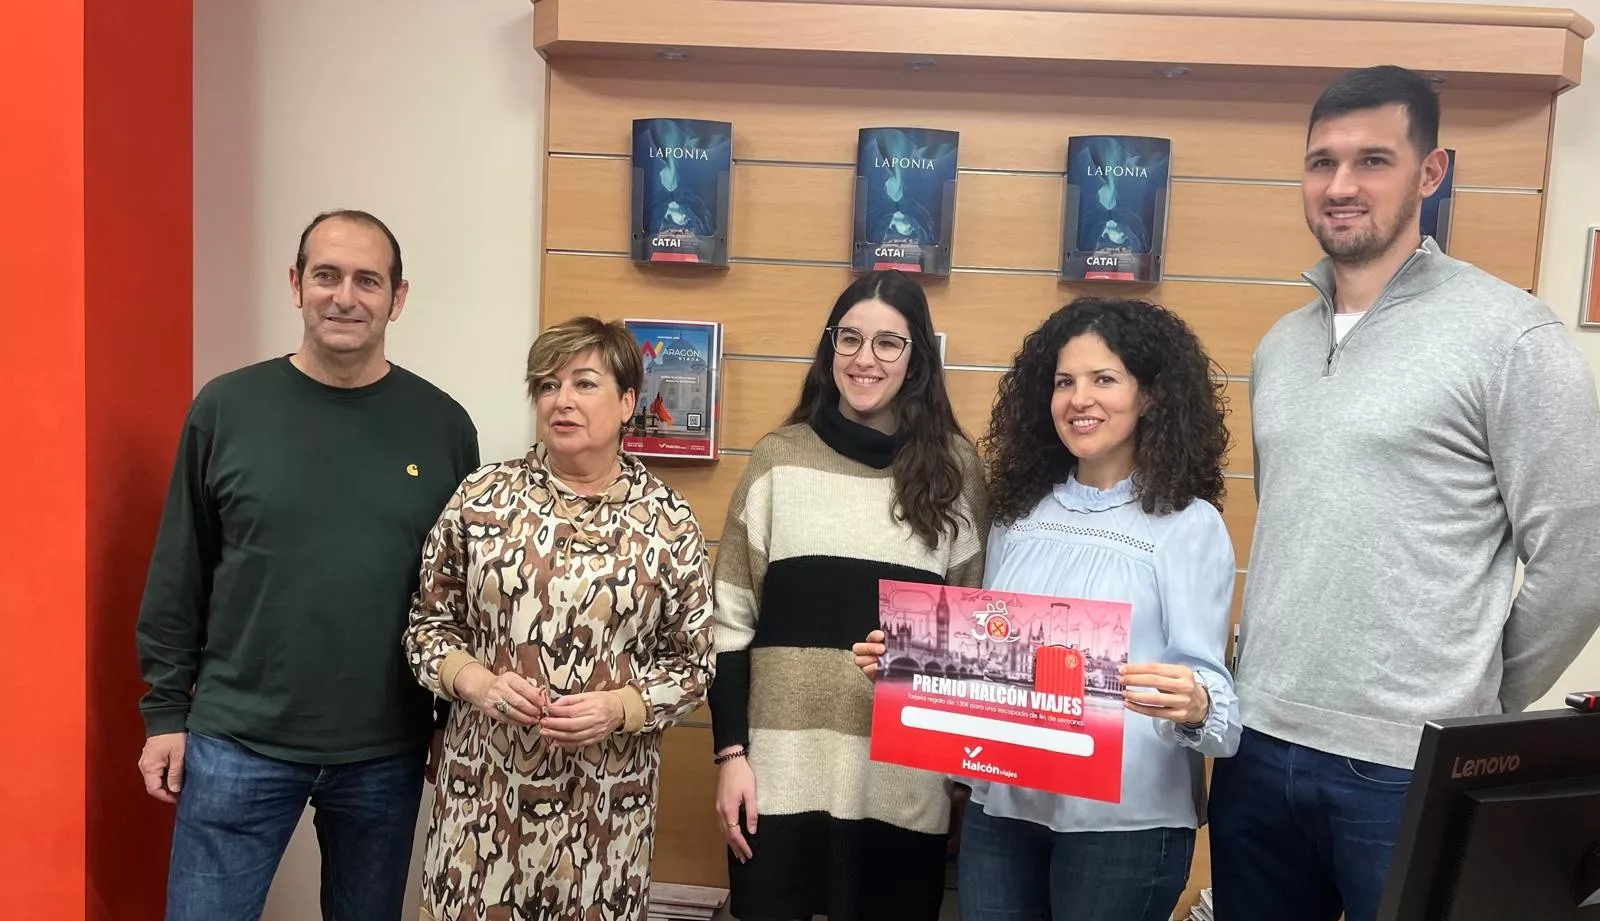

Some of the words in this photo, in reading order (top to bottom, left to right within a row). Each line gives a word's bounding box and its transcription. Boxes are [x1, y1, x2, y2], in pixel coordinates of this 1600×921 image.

[649, 147, 708, 160] LAPONIA
[874, 157, 935, 170] LAPONIA
[1087, 165, 1148, 178] LAPONIA
[652, 238, 681, 248] CATAI
[874, 248, 905, 258] CATAI
[1086, 257, 1118, 266] CATAI
[912, 673, 967, 698] PREMIO
[969, 682, 1028, 708] HALCÓN
[1030, 691, 1082, 716] VIAJES
[928, 696, 946, 704] regalo
[969, 703, 985, 711] para
[985, 705, 997, 713] una
[997, 708, 1029, 719] escapada
[1029, 711, 1038, 719] de
[1452, 754, 1521, 779] Lenovo
